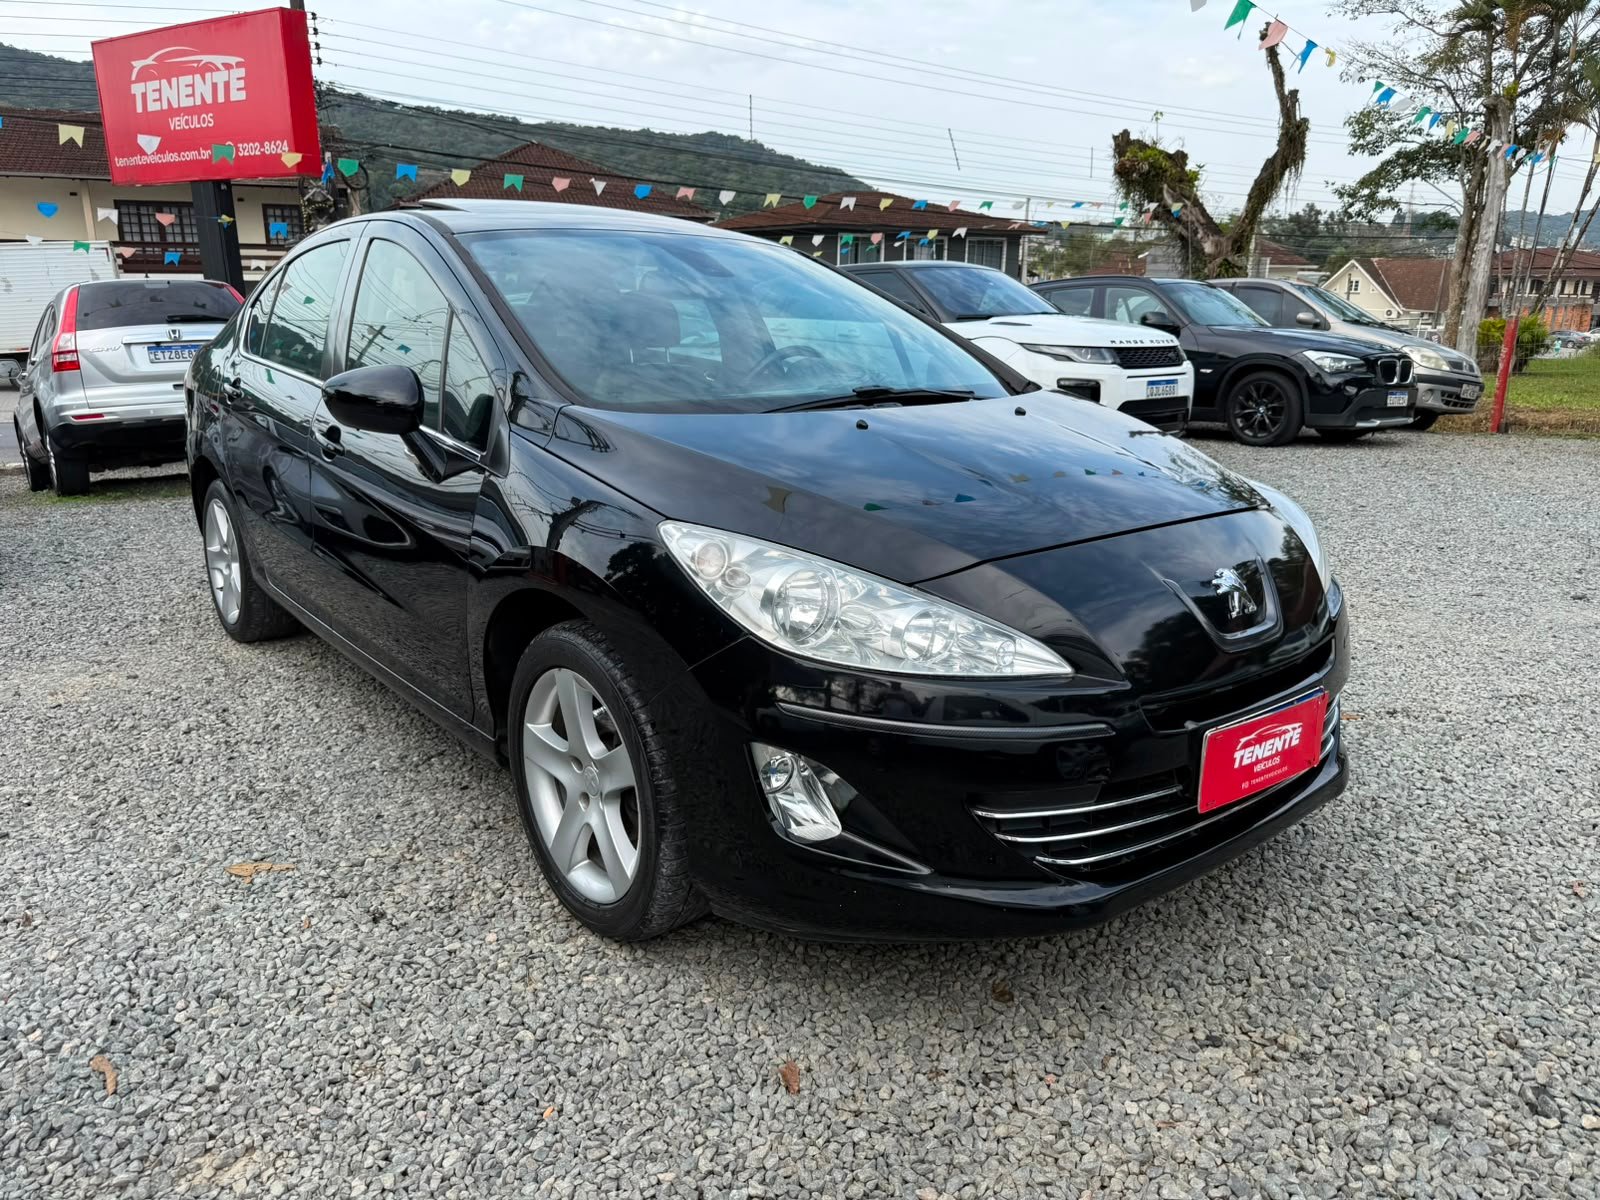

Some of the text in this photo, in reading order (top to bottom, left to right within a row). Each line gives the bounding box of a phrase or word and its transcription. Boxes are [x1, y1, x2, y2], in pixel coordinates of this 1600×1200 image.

[131, 68, 247, 113] TENENTE
[169, 113, 214, 131] VEÍCULOS
[115, 140, 289, 167] tenenteveiculos.com.br 3202-8624
[153, 350, 196, 361] ETZ8E8
[1234, 727, 1302, 769] TENENTE
